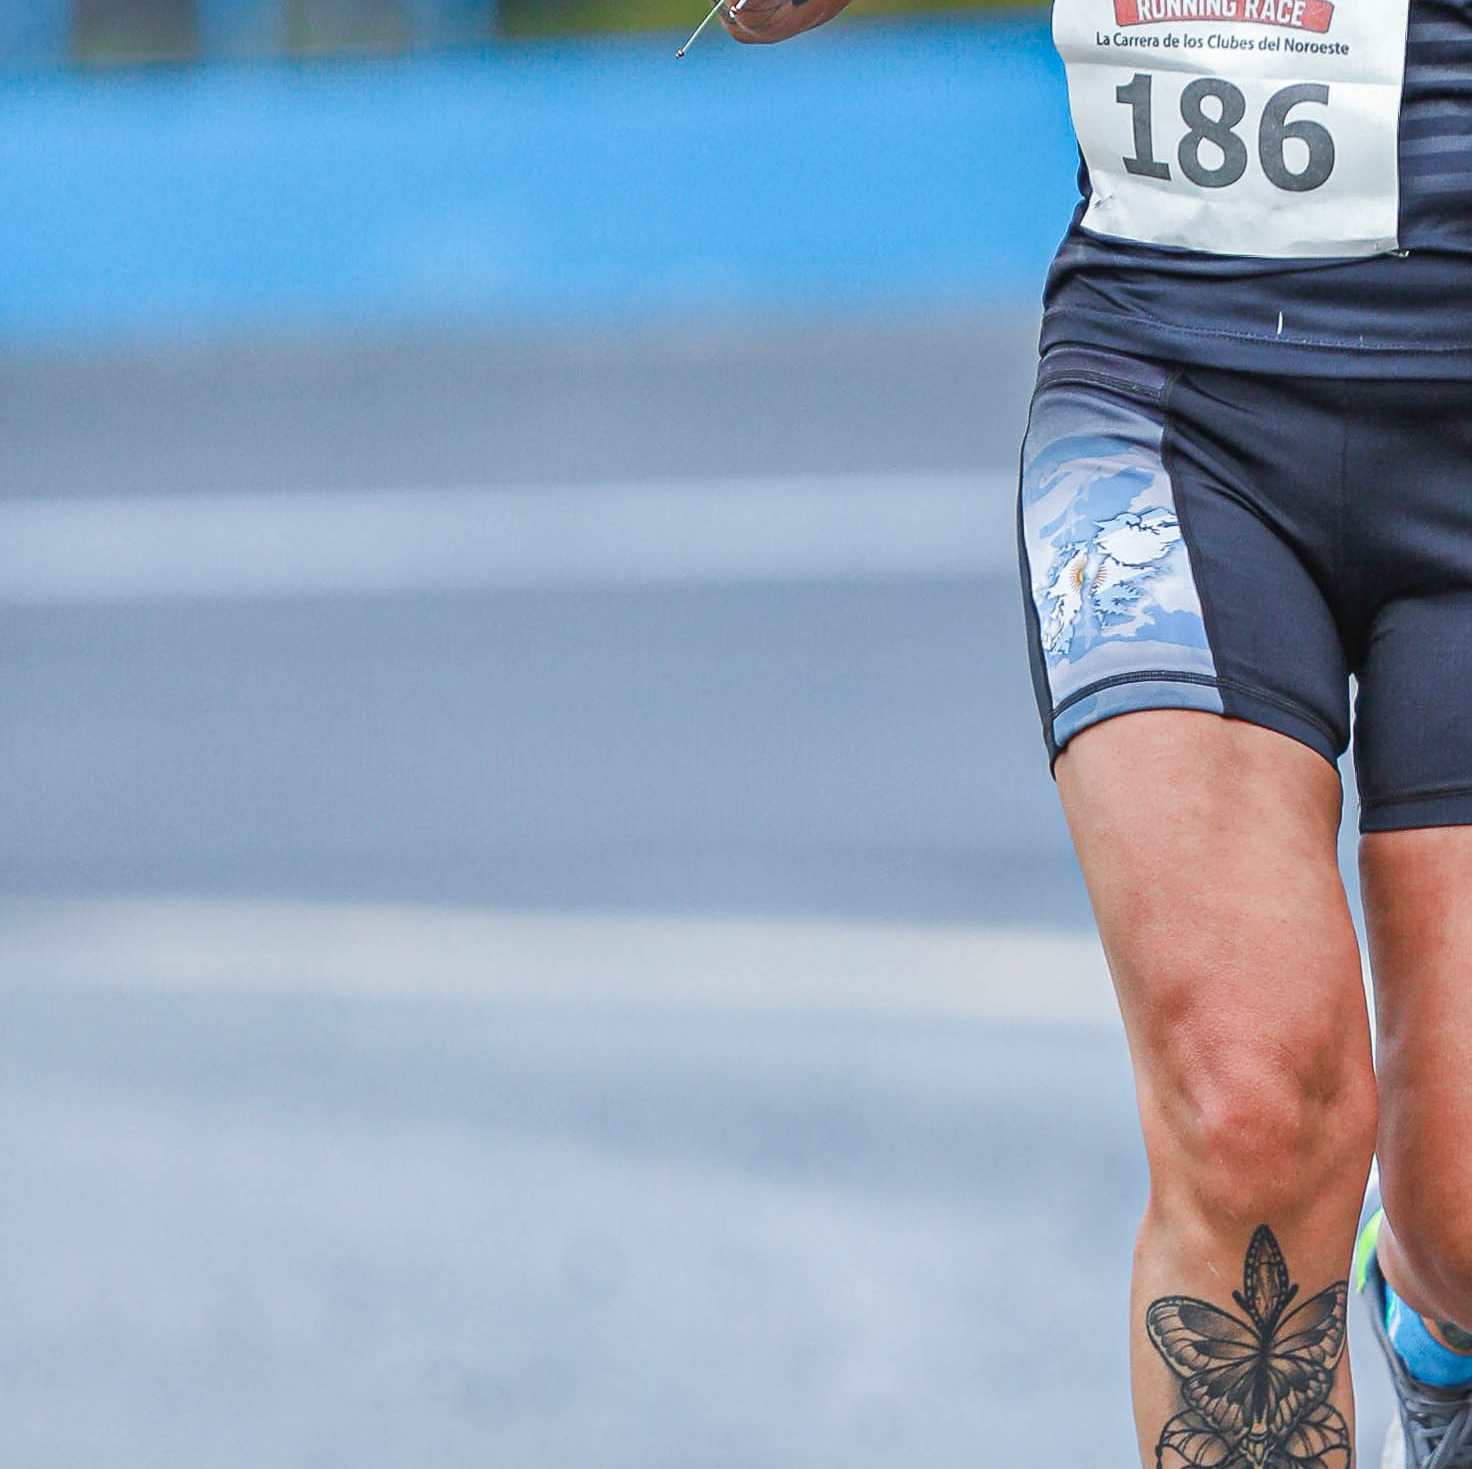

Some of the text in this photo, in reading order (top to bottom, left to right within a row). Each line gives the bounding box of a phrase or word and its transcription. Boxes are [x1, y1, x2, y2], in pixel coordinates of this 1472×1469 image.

[1096, 31, 1350, 56] La Carrera de los Clubes del Noroeste
[1115, 73, 1336, 193] 186
